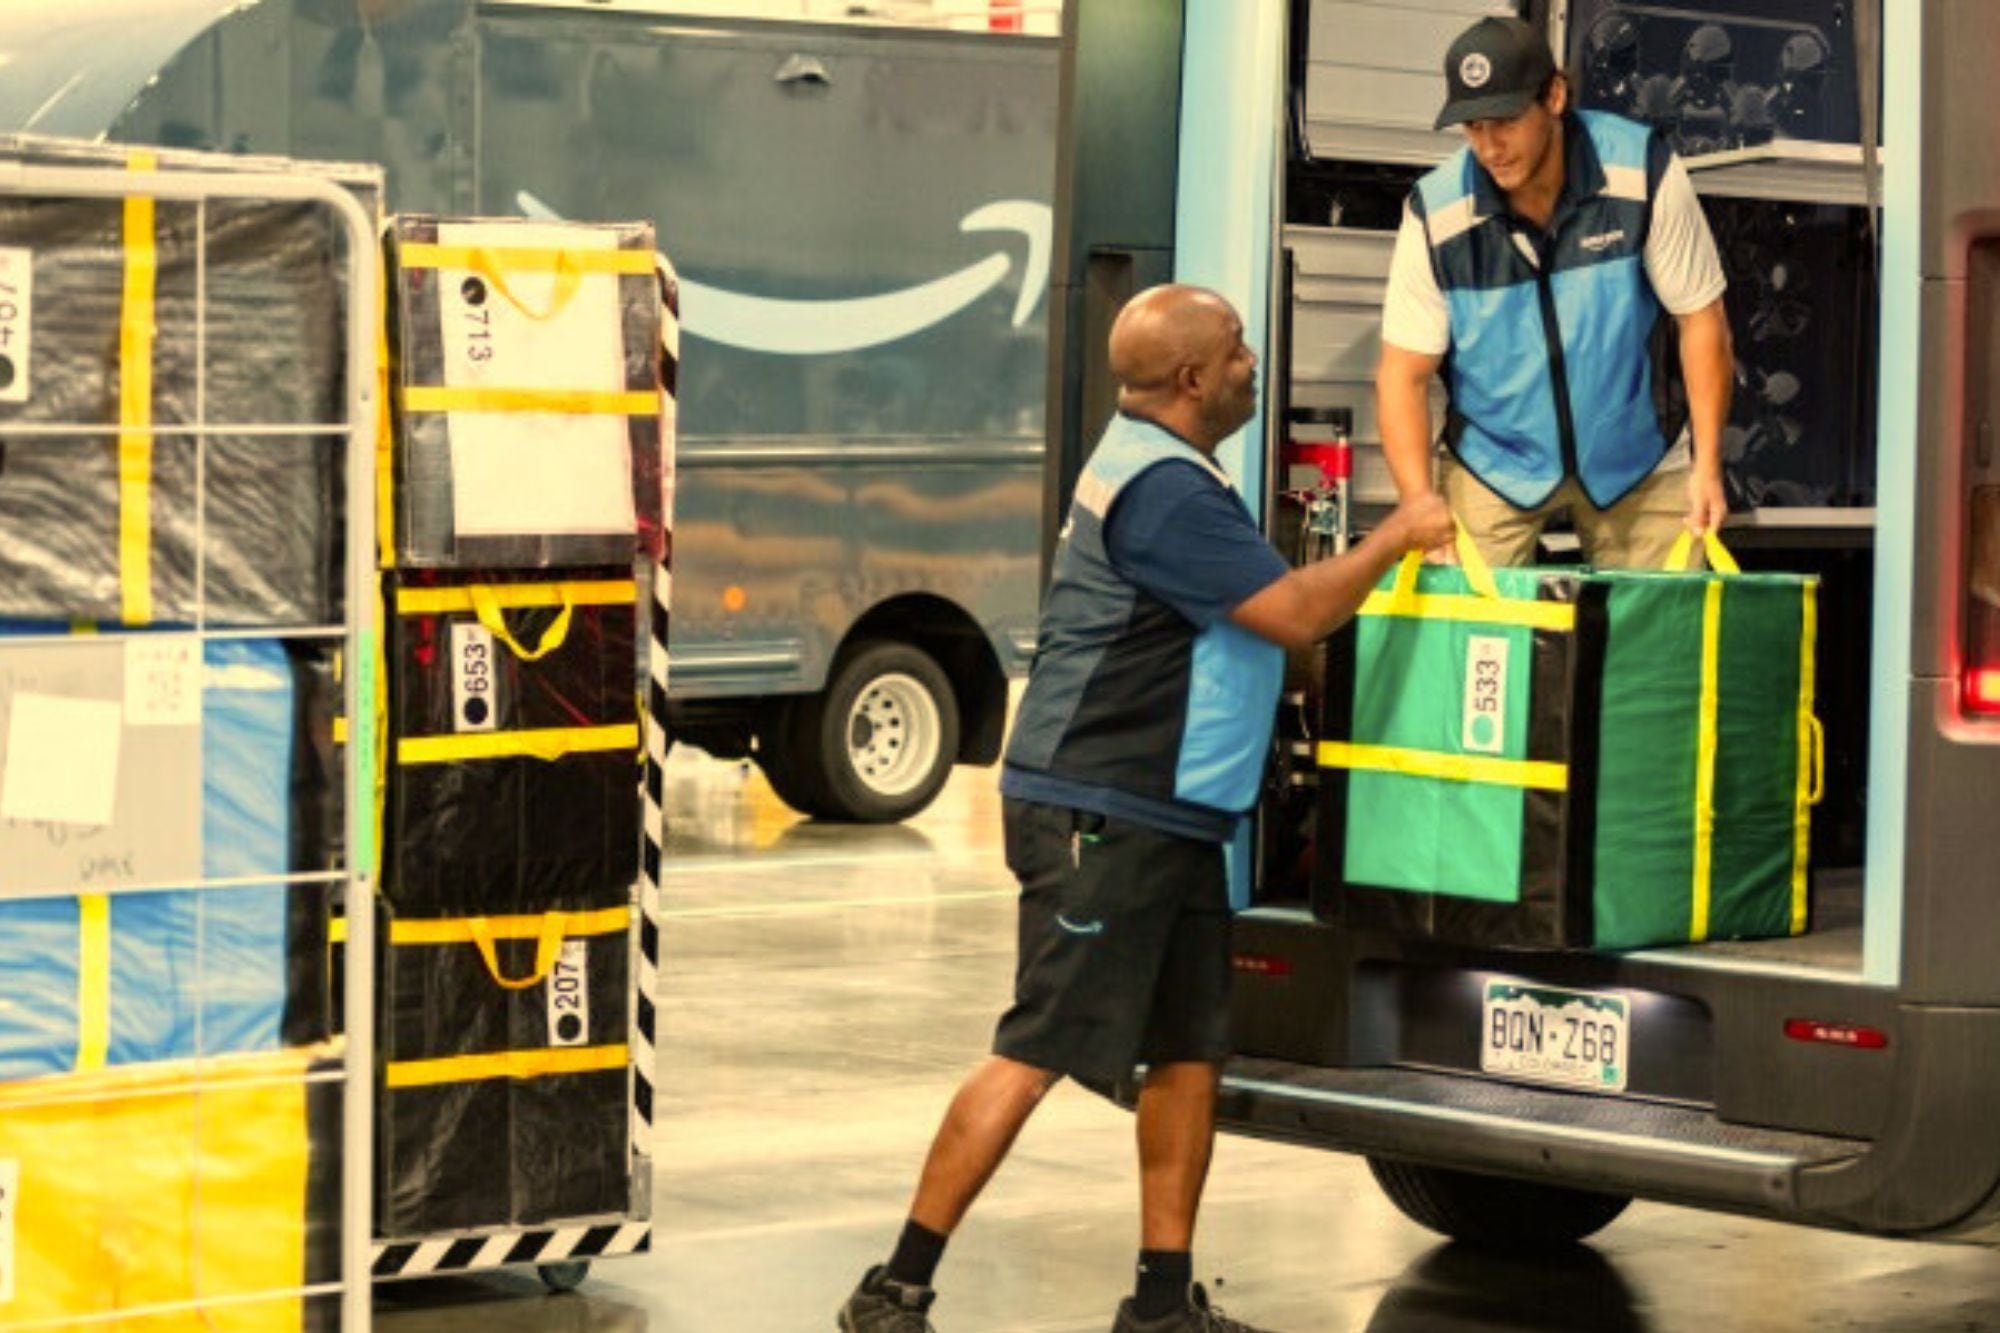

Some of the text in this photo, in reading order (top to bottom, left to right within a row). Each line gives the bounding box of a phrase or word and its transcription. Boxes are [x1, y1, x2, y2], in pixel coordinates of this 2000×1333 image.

[464, 309, 492, 361] 713
[464, 643, 488, 692] 653
[1474, 660, 1500, 712] 533
[554, 961, 579, 1009] 207
